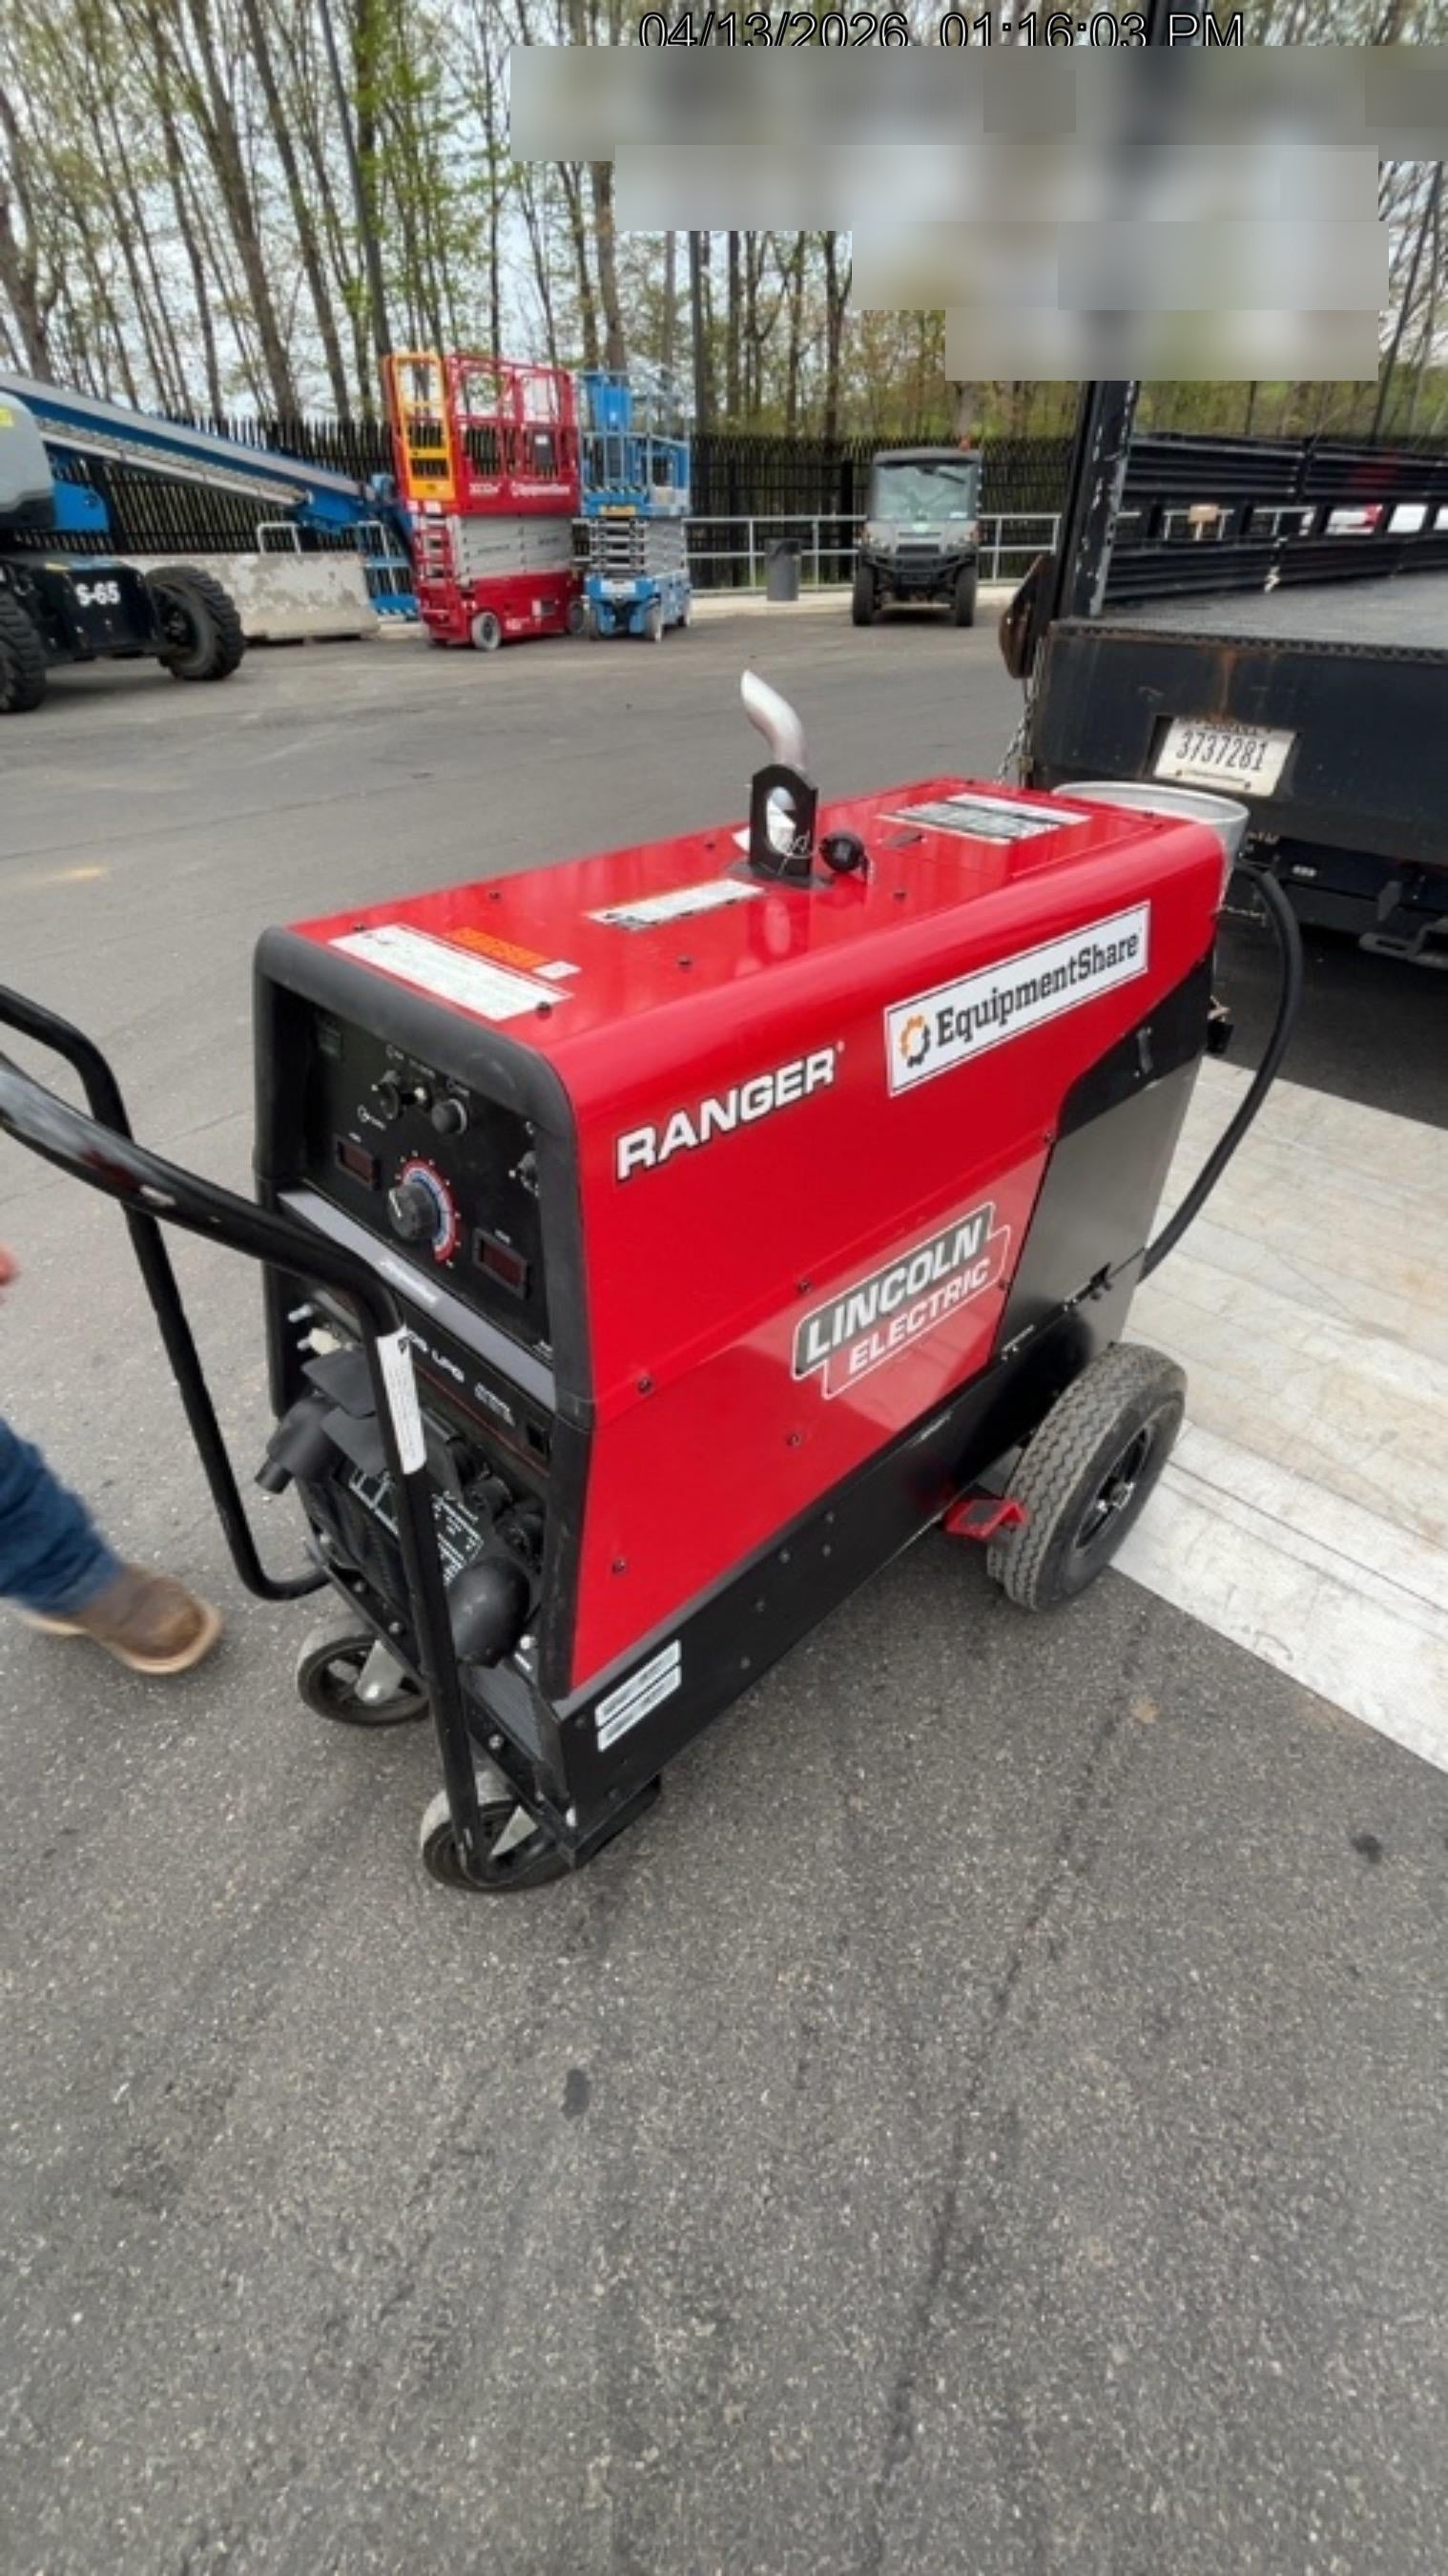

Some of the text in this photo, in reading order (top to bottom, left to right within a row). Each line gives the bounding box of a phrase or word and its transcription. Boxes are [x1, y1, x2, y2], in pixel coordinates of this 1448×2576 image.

[75, 581, 121, 608] S-65
[1175, 728, 1269, 772] 3737281
[935, 932, 1140, 1048] EquipmentShare
[616, 1046, 836, 1182] RANGER
[806, 1216, 983, 1363] LINCOLN
[848, 1257, 991, 1375] ELECTRIC
